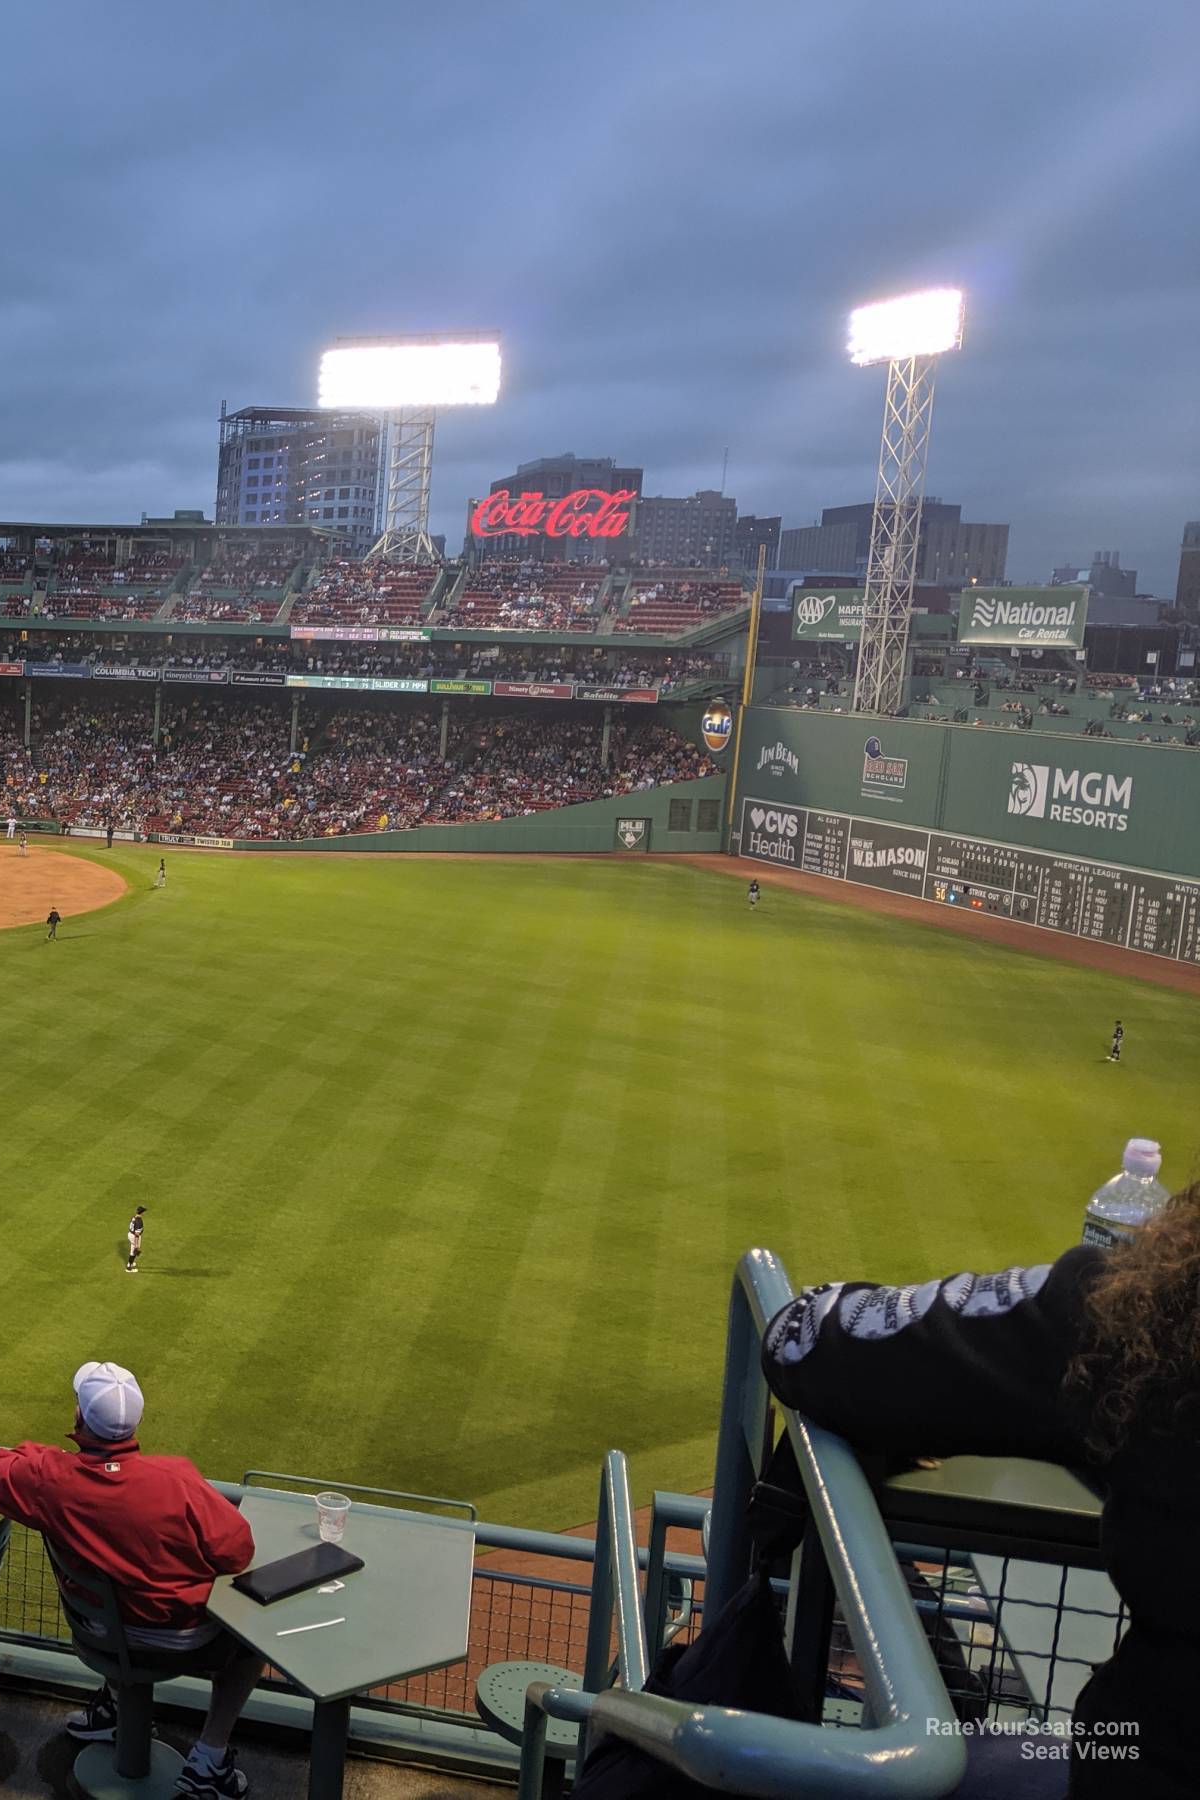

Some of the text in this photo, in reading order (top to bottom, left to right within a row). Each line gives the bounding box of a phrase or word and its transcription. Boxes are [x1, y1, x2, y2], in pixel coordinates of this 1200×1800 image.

[471, 489, 637, 538] Coca-Cola
[800, 602, 822, 622] AAA
[1018, 628, 1069, 640] Car Rental
[95, 668, 157, 678] COLUMBIA TECH
[166, 672, 193, 680] vineyard
[375, 681, 398, 689] SLIDER
[508, 686, 529, 694] Ninety
[583, 691, 618, 700] Safelite
[702, 716, 732, 735] Gulf
[756, 741, 799, 776] JIM BEAM
[866, 773, 903, 783] SCHOLARS
[1052, 768, 1133, 810] MGM
[1050, 804, 1128, 832] RESORTS
[620, 820, 644, 830] MLB
[765, 810, 798, 838] CVS
[161, 835, 180, 843] TRULY
[196, 838, 219, 846] TWISTED
[748, 832, 796, 862] Health
[951, 840, 1019, 859] FENWAY PARK
[942, 857, 959, 866] CHICAGO
[892, 868, 908, 878] SINCE
[941, 866, 958, 875] BOSTON
[1053, 861, 1121, 879] AMERICAN LEAGUE
[1052, 887, 1062, 895] BAL
[1175, 884, 1200, 895] NATIO
[968, 888, 986, 898] STRIKE
[988, 892, 1000, 901] OUT
[1148, 900, 1160, 908] LAD
[1148, 908, 1158, 916] ARI
[1048, 918, 1059, 926] CLE
[1093, 921, 1104, 929] TEX
[1146, 916, 1157, 925] ATL
[1091, 928, 1103, 937] DET
[1144, 924, 1157, 933] CHC
[1143, 933, 1156, 942] NYM
[1143, 941, 1154, 949] PHI
